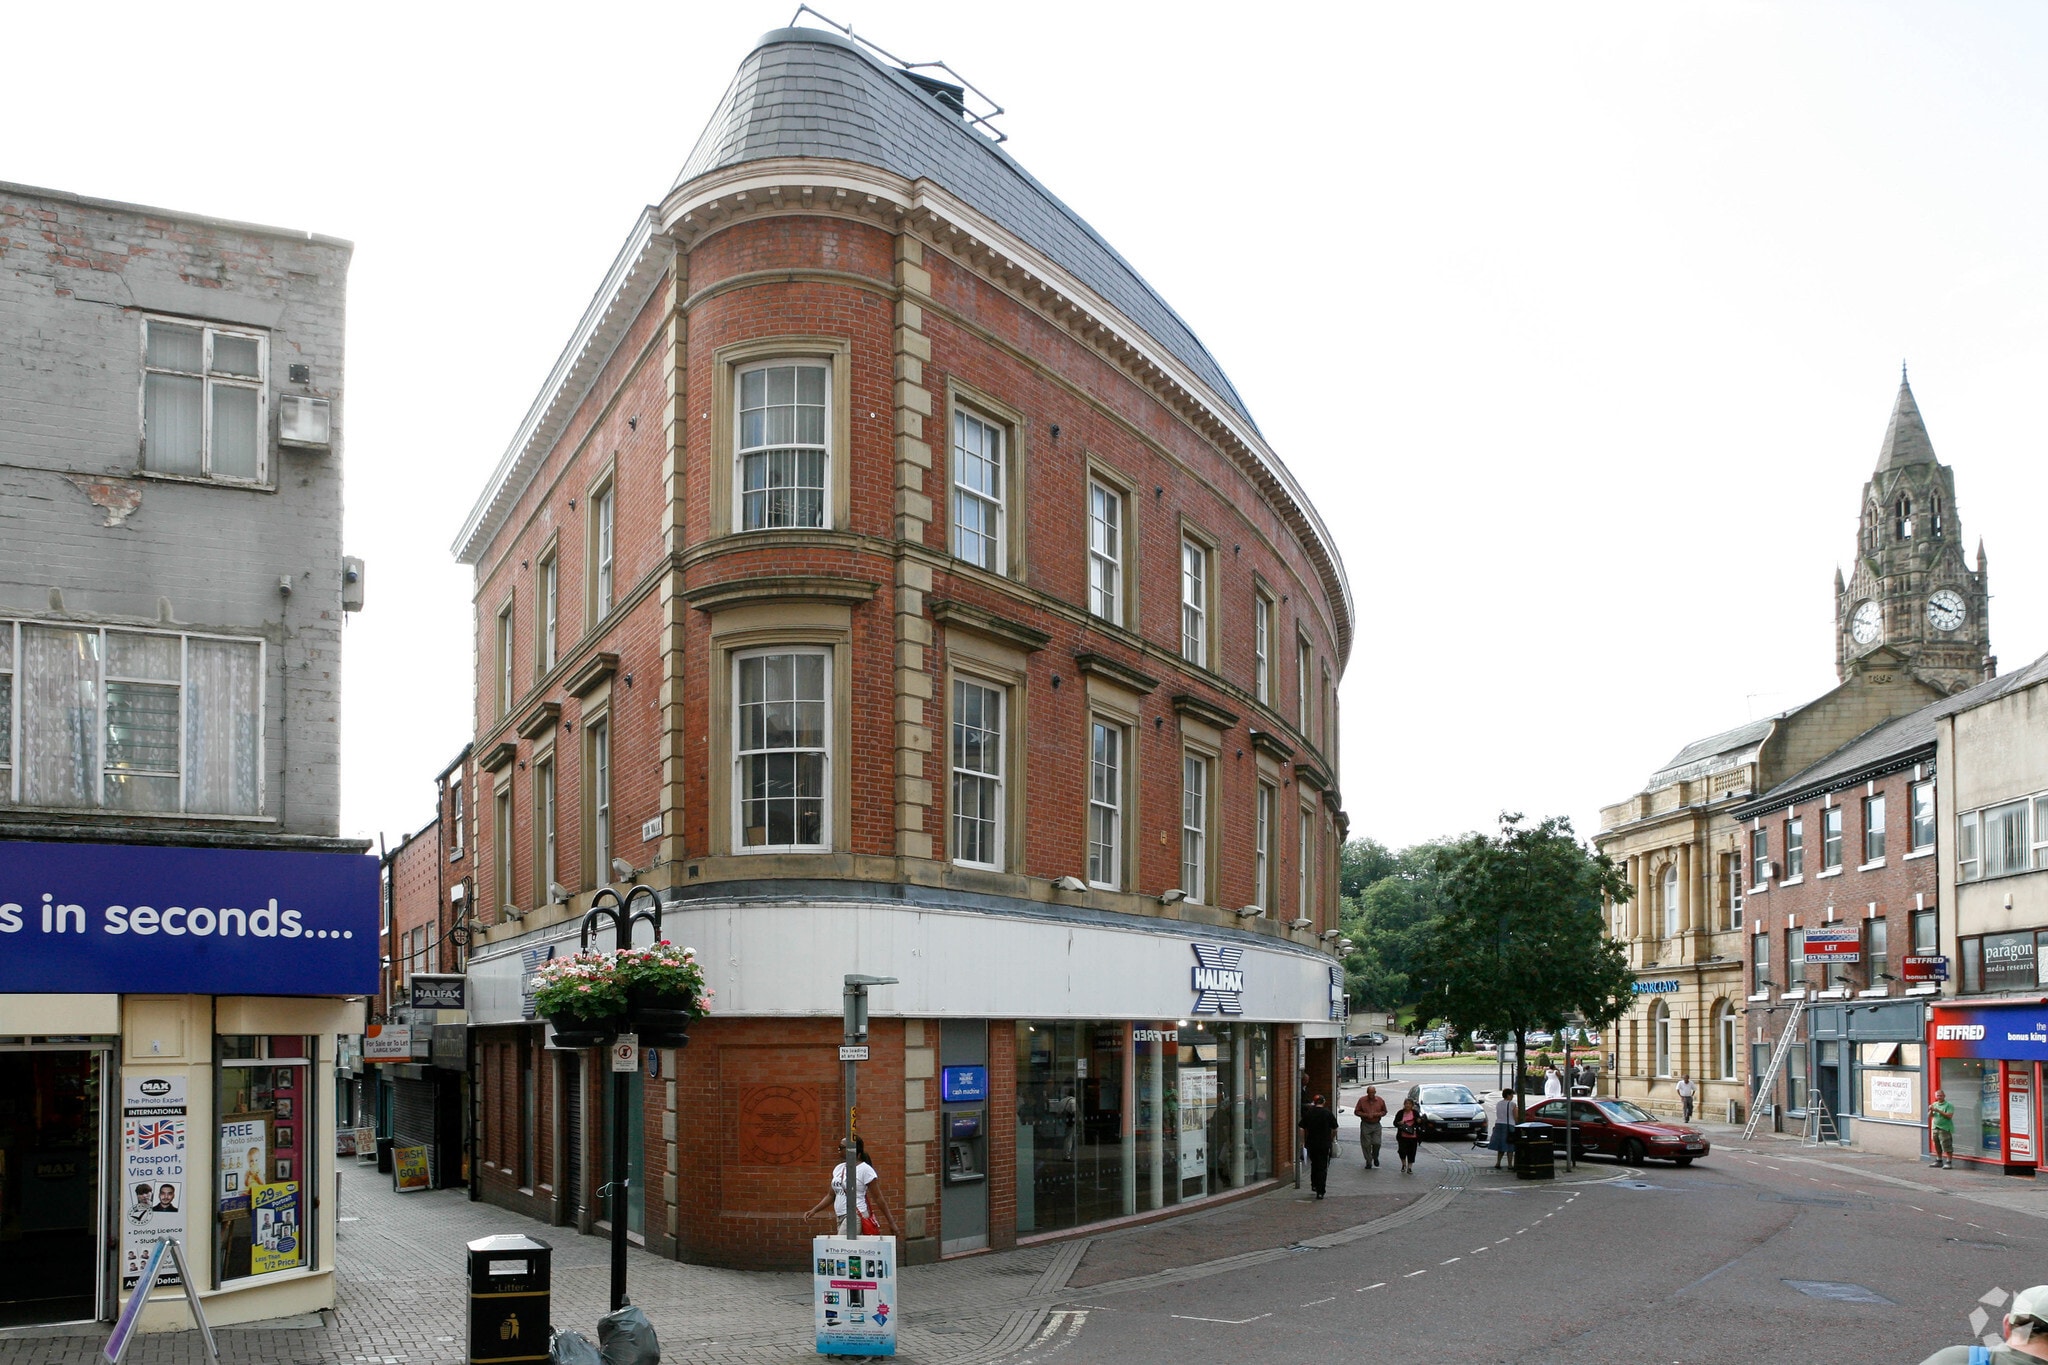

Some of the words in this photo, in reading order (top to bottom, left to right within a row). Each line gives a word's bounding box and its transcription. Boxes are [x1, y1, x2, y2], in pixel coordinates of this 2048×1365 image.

[42, 893, 86, 933] in
[1985, 944, 2034, 963] paragon
[1986, 965, 2005, 973] media
[2006, 962, 2034, 971] research
[1195, 967, 1243, 991] HALIFAX
[1639, 981, 1679, 993] BARCLAYS
[415, 989, 461, 998] HALIFAX
[2036, 1022, 2047, 1031] the
[1936, 1025, 1985, 1040] BETFRED
[2007, 1032, 2029, 1041] bonus
[2030, 1032, 2047, 1043] king
[142, 1082, 169, 1090] MAX
[128, 1108, 183, 1116] INTERNATIONAL
[221, 1124, 253, 1137] FREE
[225, 1136, 245, 1146] photo
[246, 1135, 264, 1144] shoot
[129, 1154, 181, 1165] Passport,
[397, 1149, 423, 1160] CASH
[128, 1167, 153, 1177] Visa
[156, 1166, 165, 1176] &
[167, 1166, 183, 1175] I.D
[400, 1166, 425, 1178] GOLD
[271, 1195, 293, 1208] Portrait
[840, 1247, 857, 1255] Phone
[264, 1261, 276, 1270] 1/2
[277, 1258, 296, 1268] Price
[498, 1284, 526, 1292] Litter
